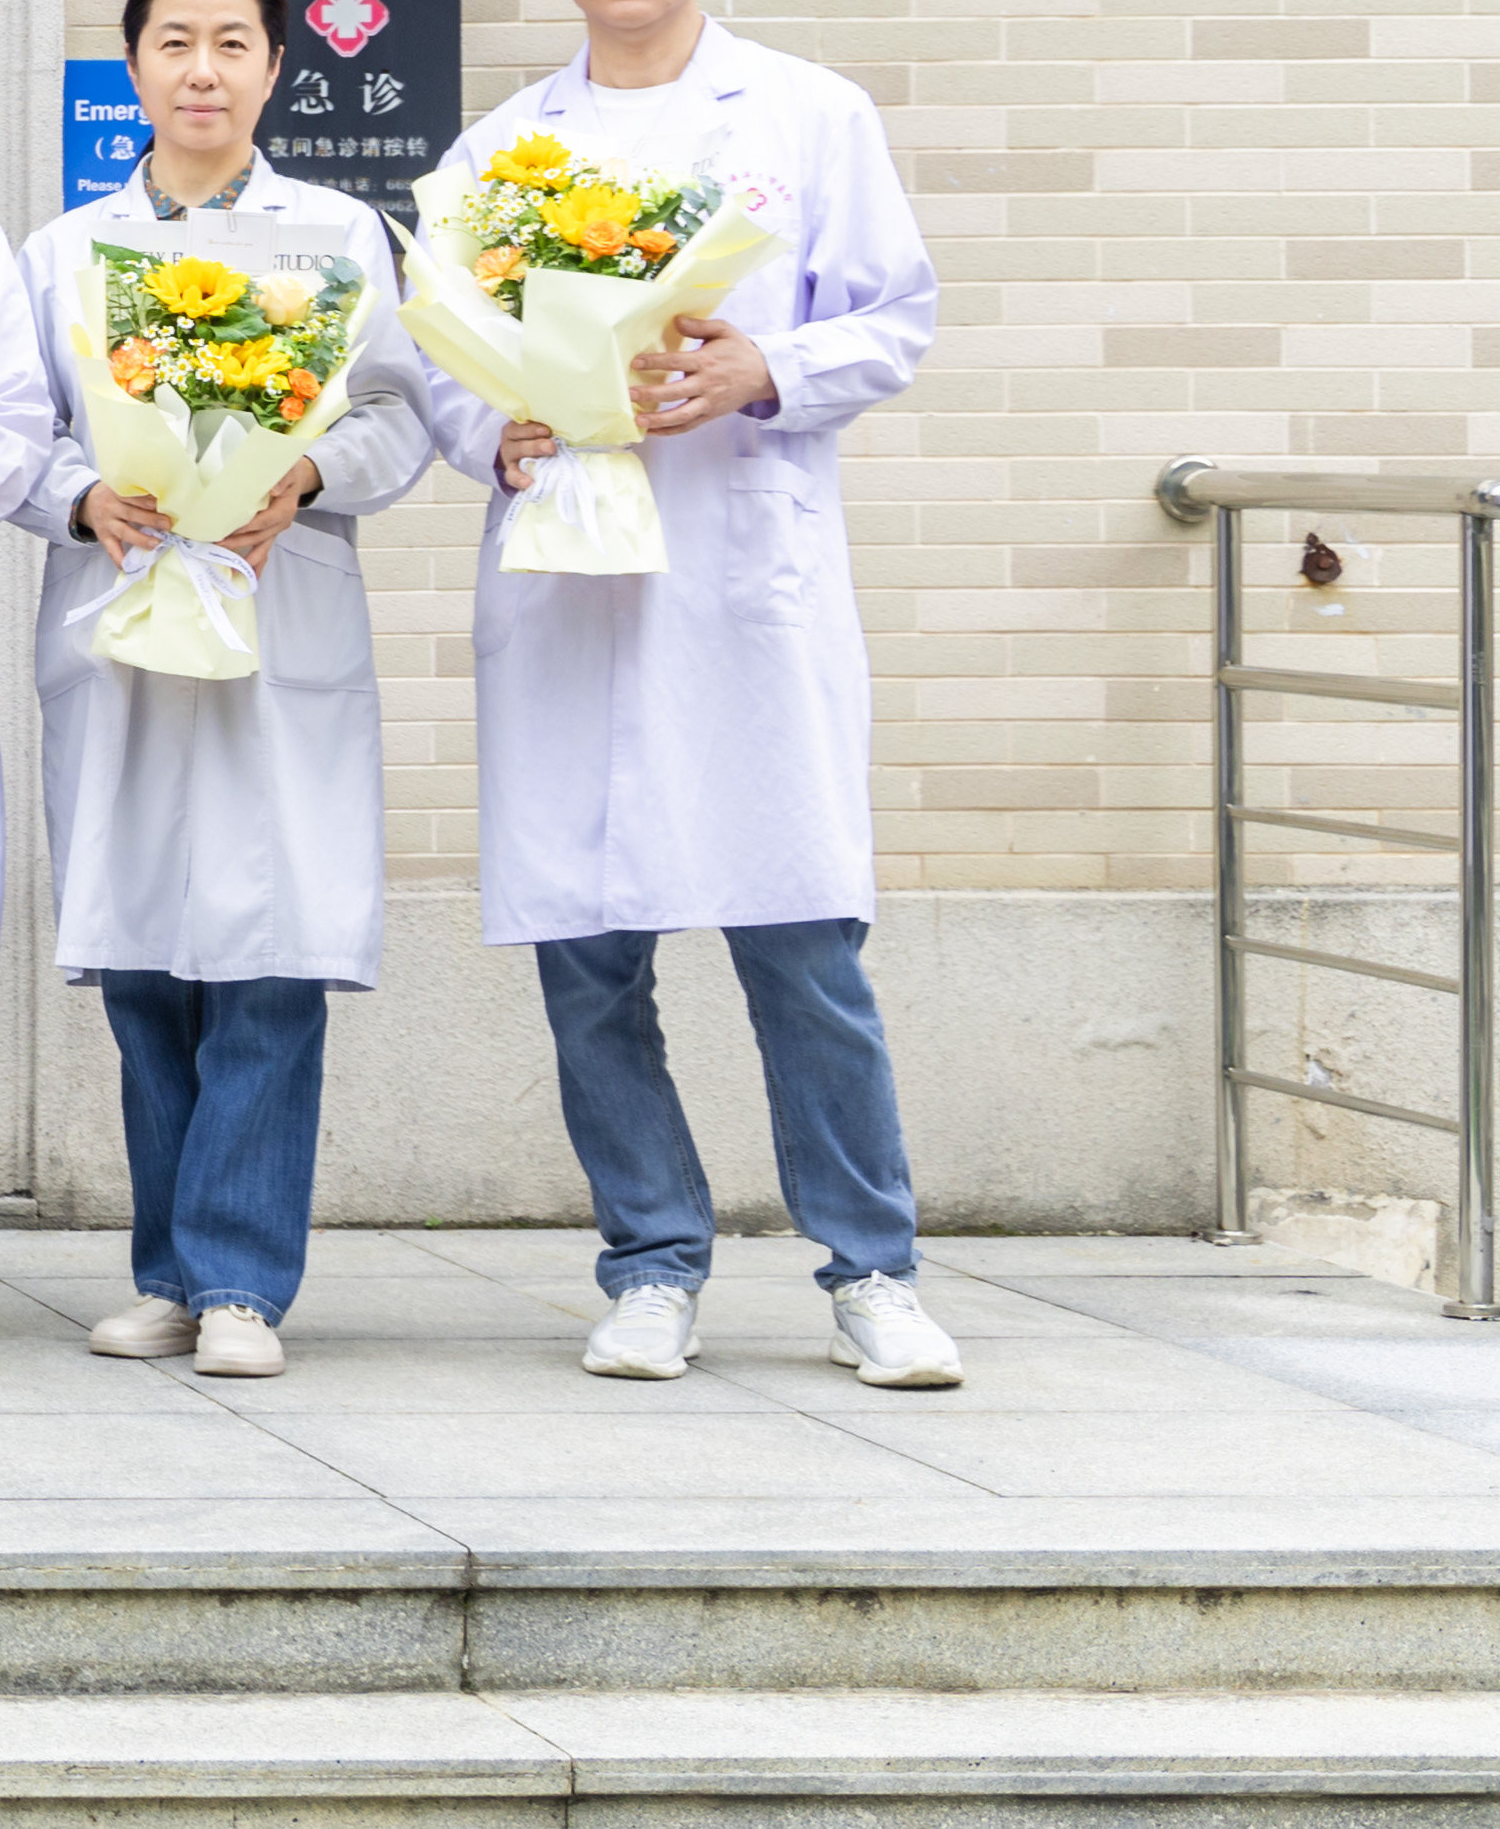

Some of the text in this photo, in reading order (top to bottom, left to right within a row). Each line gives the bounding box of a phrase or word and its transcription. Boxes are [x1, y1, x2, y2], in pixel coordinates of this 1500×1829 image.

[289, 69, 406, 115] 急诊
[268, 137, 428, 158] 夜间急诊请按铃
[77, 178, 122, 191] Please
[274, 254, 336, 271] TUDIO
